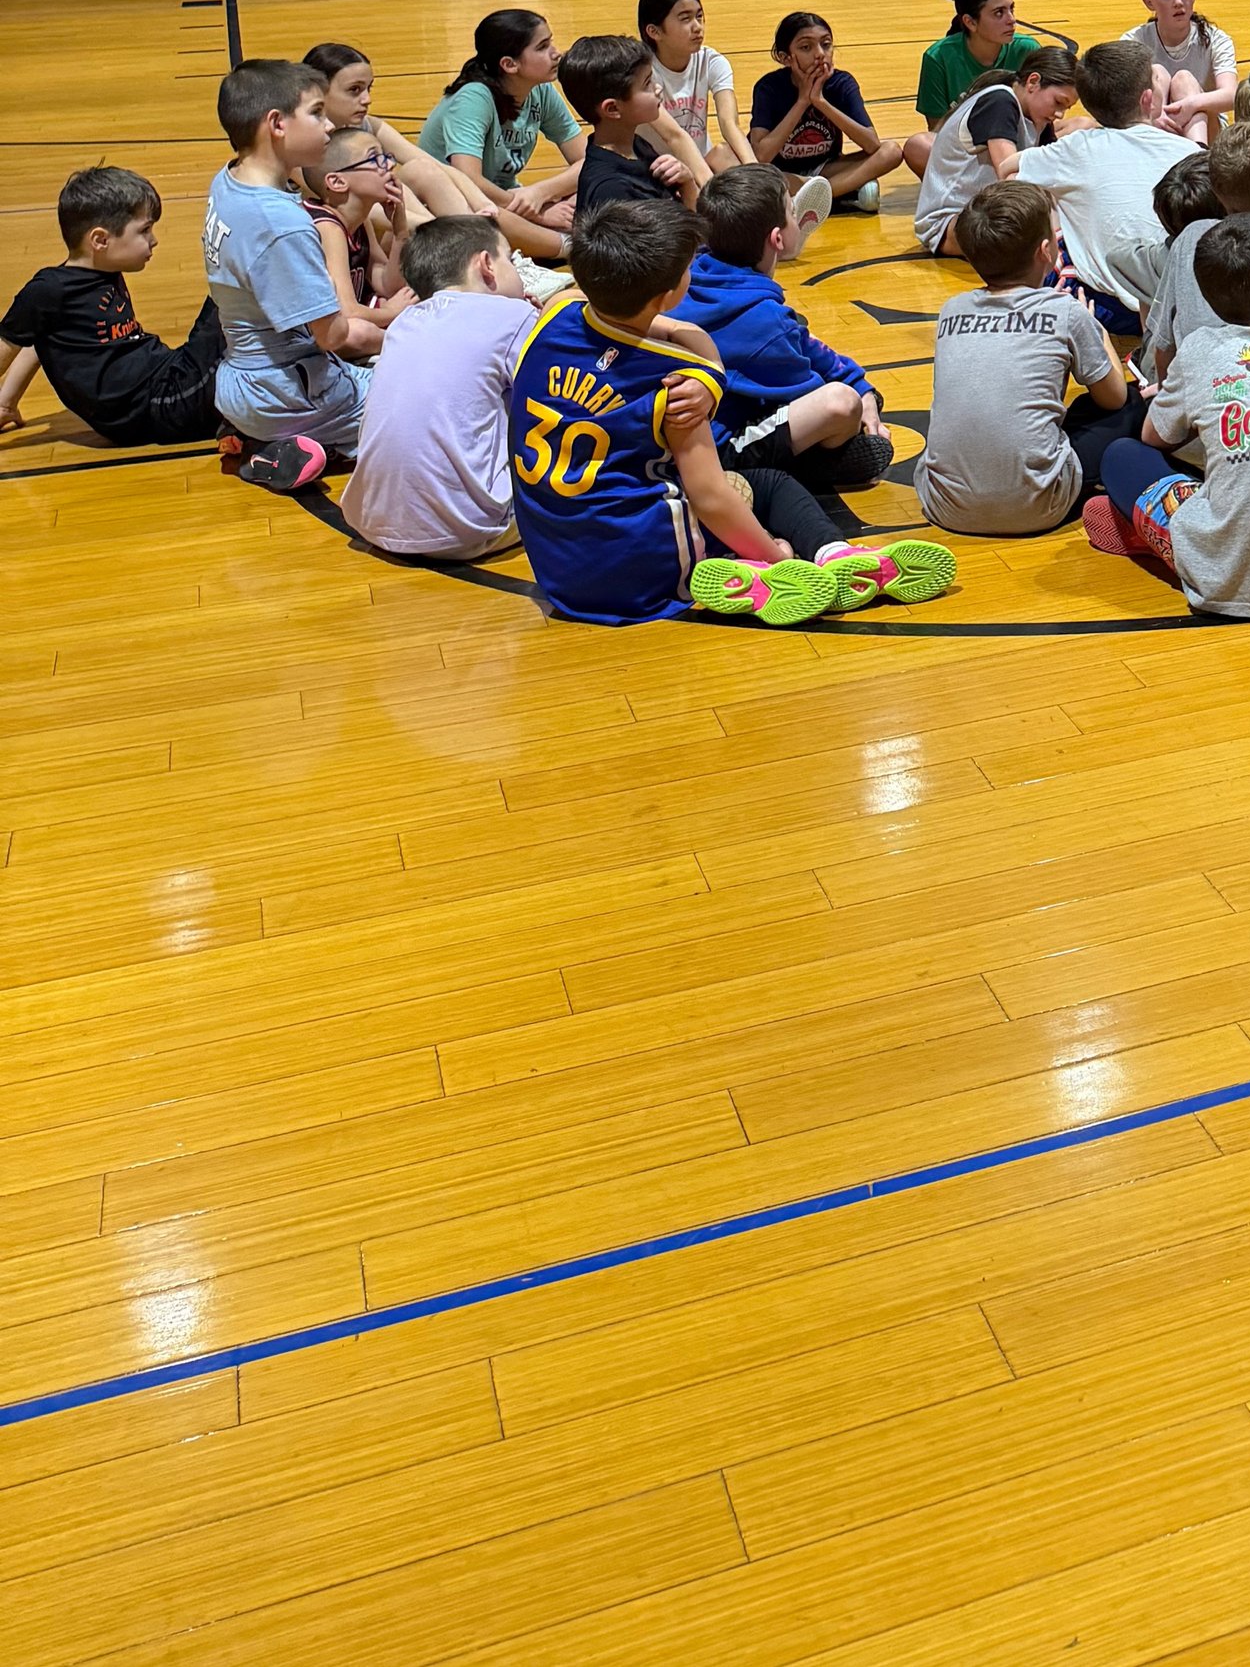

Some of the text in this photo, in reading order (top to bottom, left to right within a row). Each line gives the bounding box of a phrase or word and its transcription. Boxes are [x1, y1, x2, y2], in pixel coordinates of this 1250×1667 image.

[937, 311, 1057, 340] OVERTIME
[548, 365, 626, 417] CURRY
[514, 396, 611, 498] 30
